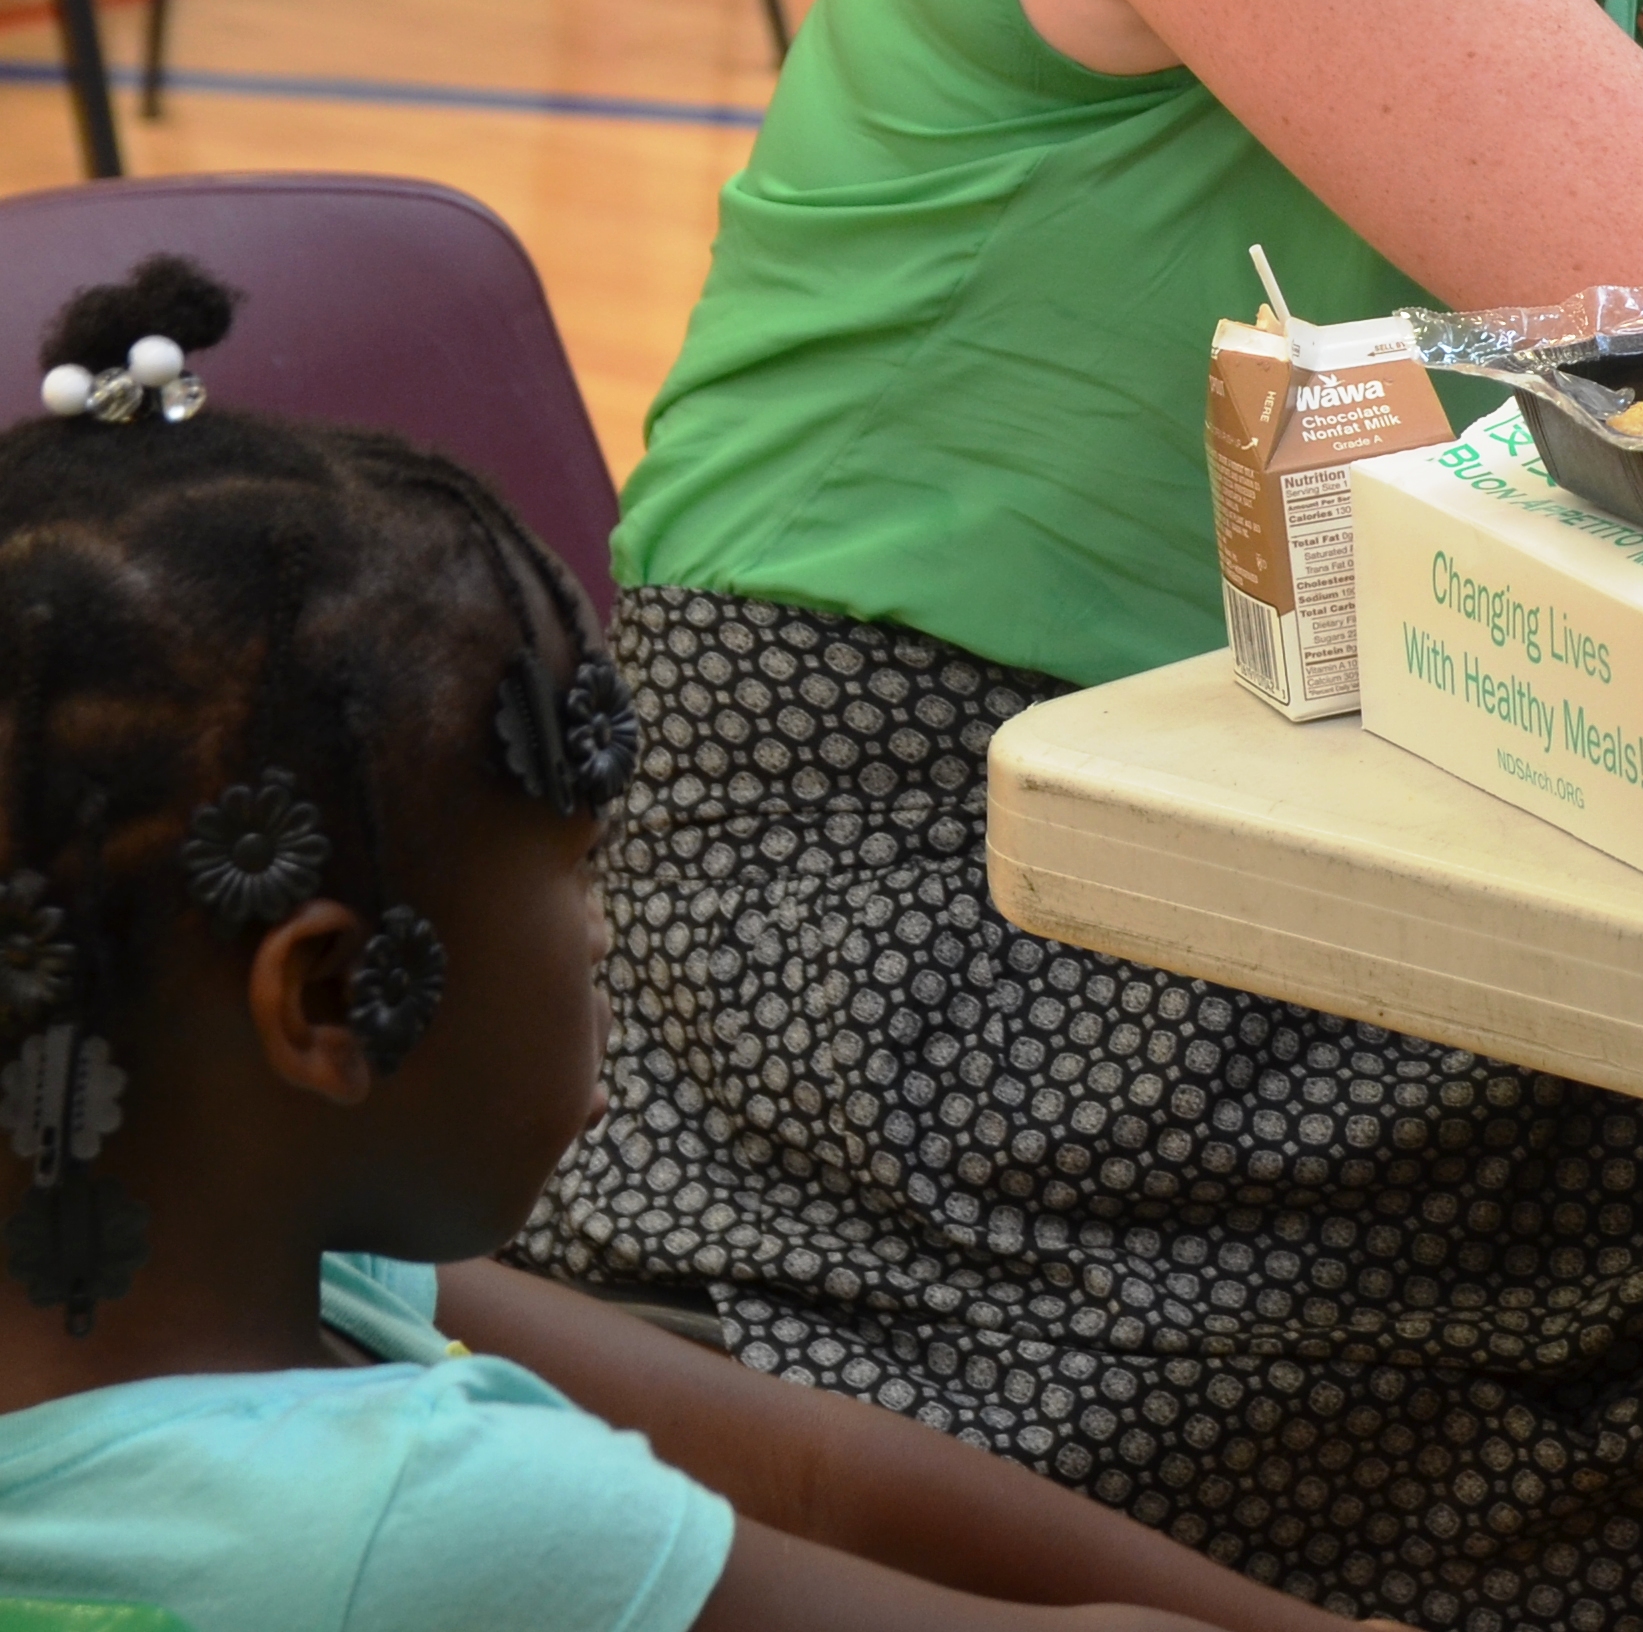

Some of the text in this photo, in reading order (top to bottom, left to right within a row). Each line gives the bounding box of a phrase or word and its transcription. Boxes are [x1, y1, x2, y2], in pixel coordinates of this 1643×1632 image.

[1296, 379, 1385, 412] Wawa
[1260, 390, 1277, 423] HERE
[1302, 404, 1391, 429] Chocolate
[1301, 413, 1402, 443] Nonfat Milk
[1332, 435, 1383, 452] Grade A
[1438, 443, 1528, 499] BUON
[1284, 470, 1346, 489] Nutrition
[1286, 480, 1348, 499] Serving Size 1
[1288, 500, 1319, 511] Amount
[1289, 506, 1351, 523] Calories 130
[1292, 536, 1319, 548] Total
[1322, 533, 1340, 543] Fat
[1304, 546, 1347, 561] Saturated
[1306, 564, 1329, 574] Trans
[1331, 560, 1345, 570] Fat
[1296, 574, 1355, 590] Cholestero
[1299, 591, 1339, 604] Sodium
[1300, 606, 1327, 618] Total
[1432, 550, 1612, 684] Changing Lives
[1312, 618, 1344, 630] Dietary
[1314, 632, 1345, 645] Sugars
[1305, 648, 1343, 659] Protein
[1306, 662, 1338, 675] Vitamin
[1307, 673, 1342, 687] Calcium
[1403, 621, 1455, 695] With
[1464, 651, 1555, 753] Healthy
[1497, 748, 1585, 810] NDSArch.ORG
